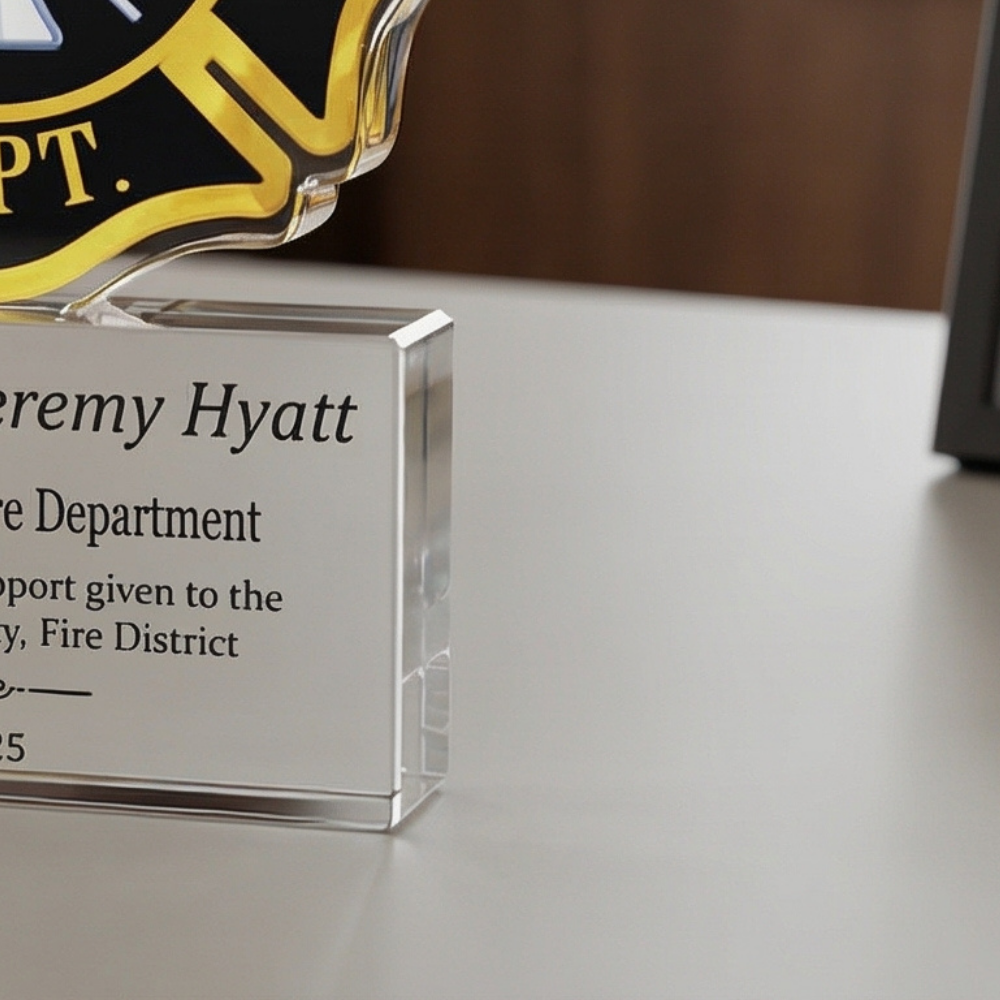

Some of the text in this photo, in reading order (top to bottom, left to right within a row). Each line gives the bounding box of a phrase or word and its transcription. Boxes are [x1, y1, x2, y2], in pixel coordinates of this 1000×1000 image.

[180, 381, 359, 455] Hyatt
[34, 487, 262, 548] Department
[85, 573, 176, 612] given
[185, 581, 219, 609] to
[229, 578, 283, 613] the
[40, 617, 103, 650] Fire
[114, 621, 239, 658] District
